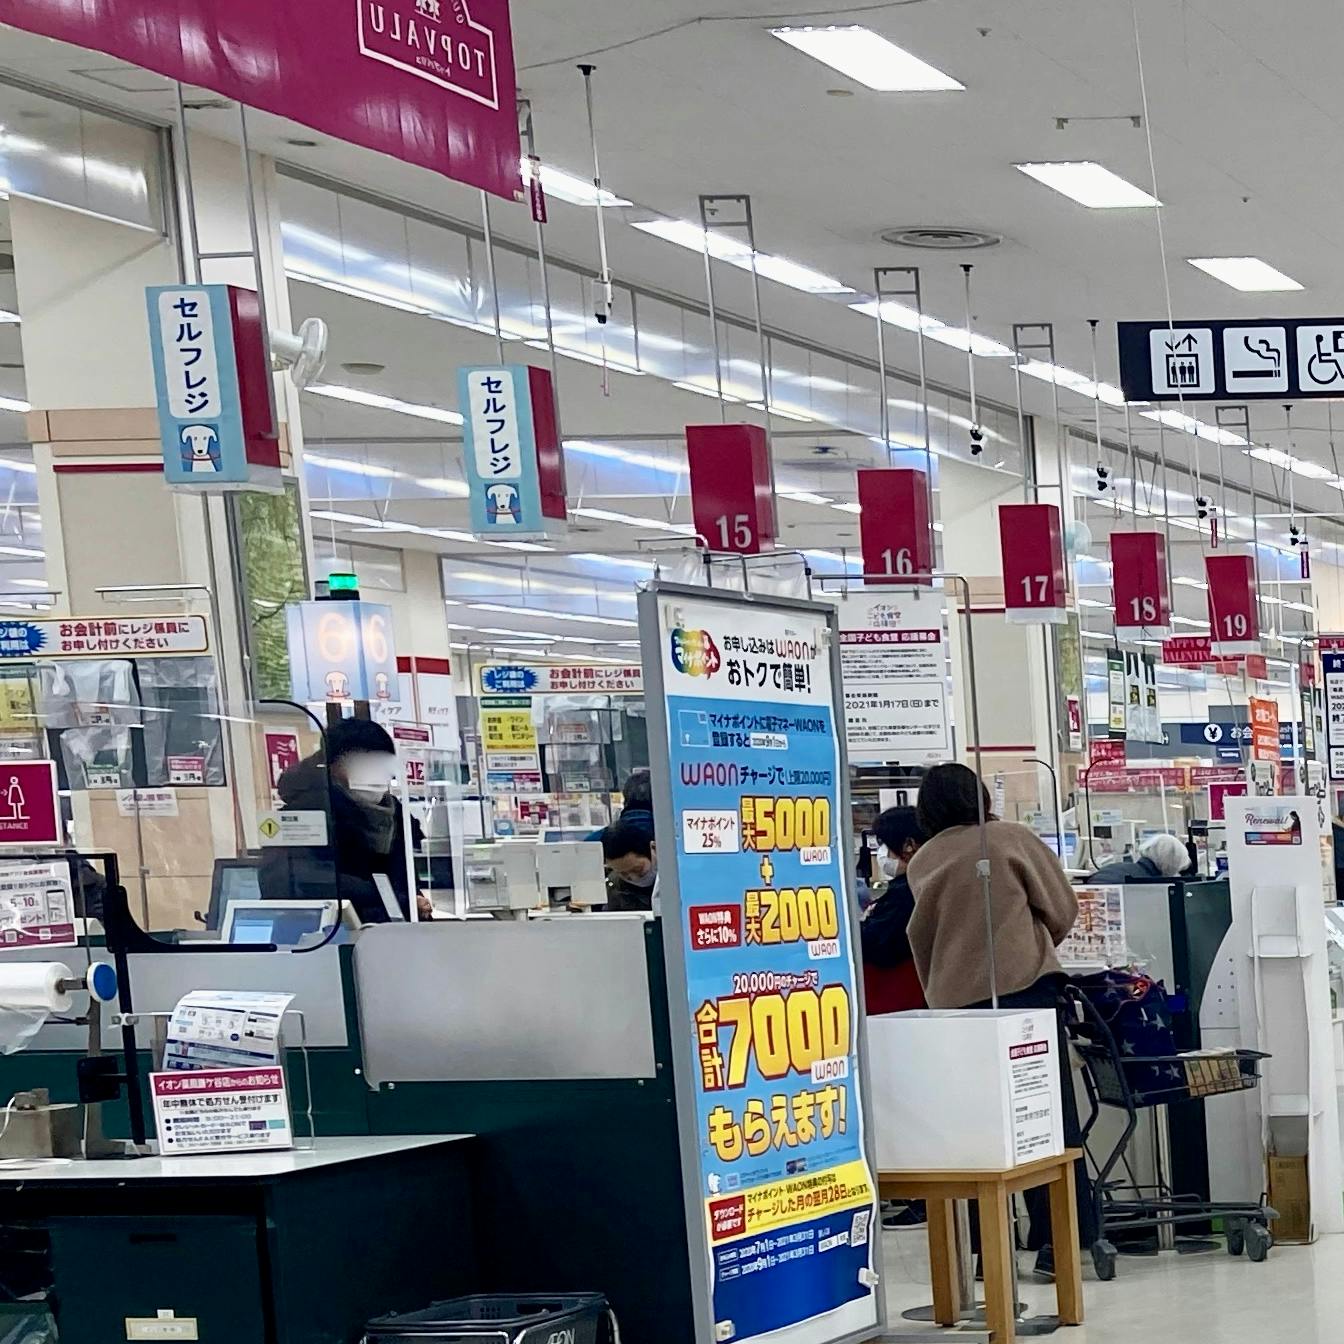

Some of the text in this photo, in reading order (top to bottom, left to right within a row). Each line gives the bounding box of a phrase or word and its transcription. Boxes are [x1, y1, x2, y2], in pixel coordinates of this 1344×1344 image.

[172, 297, 210, 414] セルフレジ
[479, 376, 512, 475] セルフレジ
[715, 513, 753, 549] 15
[881, 548, 912, 577] 16
[1020, 575, 1050, 602] 17
[1130, 598, 1157, 622] 18
[1223, 613, 1248, 638] 19
[61, 637, 169, 651] お申し付けください
[686, 816, 736, 831] マイナポイント
[754, 796, 831, 852] 5000
[702, 832, 722, 849] 25%
[803, 849, 829, 863] WAON
[760, 886, 839, 946] 2000
[812, 942, 838, 957] WAON
[695, 982, 850, 1093] 合計 7000
[815, 1059, 845, 1081] WAON
[708, 1084, 847, 1162] もらえます!
